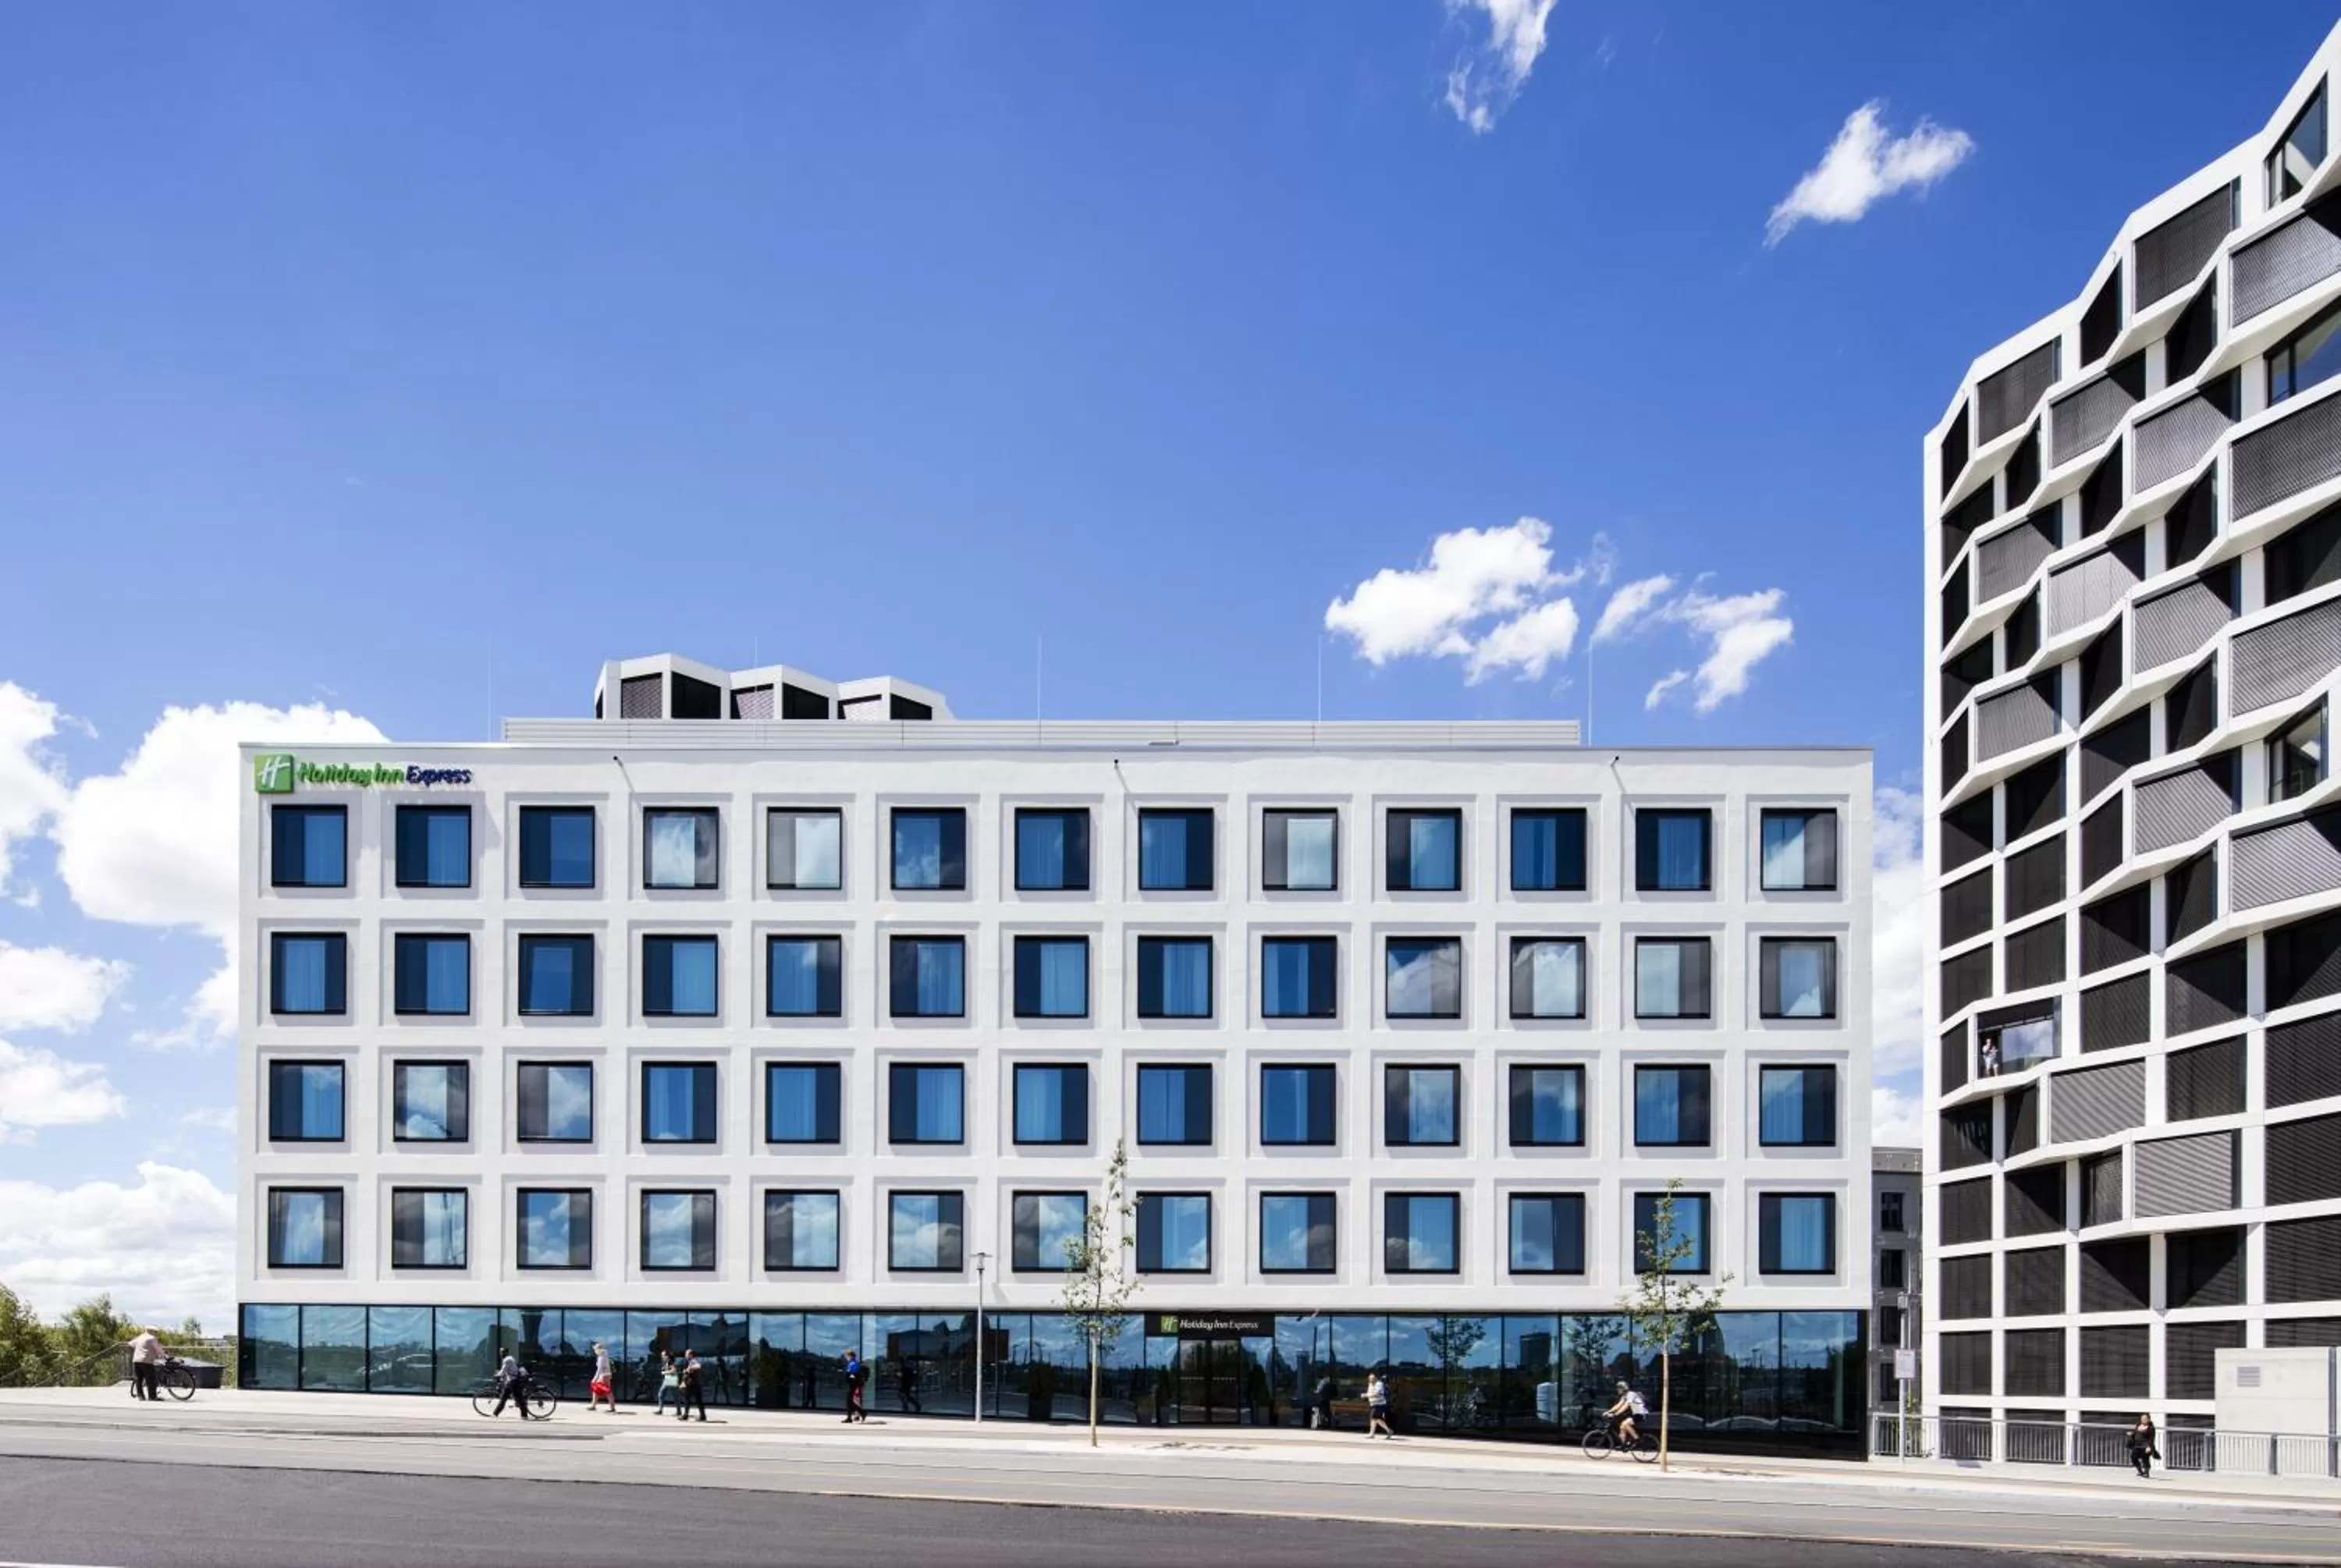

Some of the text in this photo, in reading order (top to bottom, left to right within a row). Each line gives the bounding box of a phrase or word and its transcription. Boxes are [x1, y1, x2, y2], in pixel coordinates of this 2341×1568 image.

[297, 761, 472, 788] Holiday Inn Express
[1179, 1318, 1213, 1332] Holiday
[1229, 1319, 1259, 1332] Express
